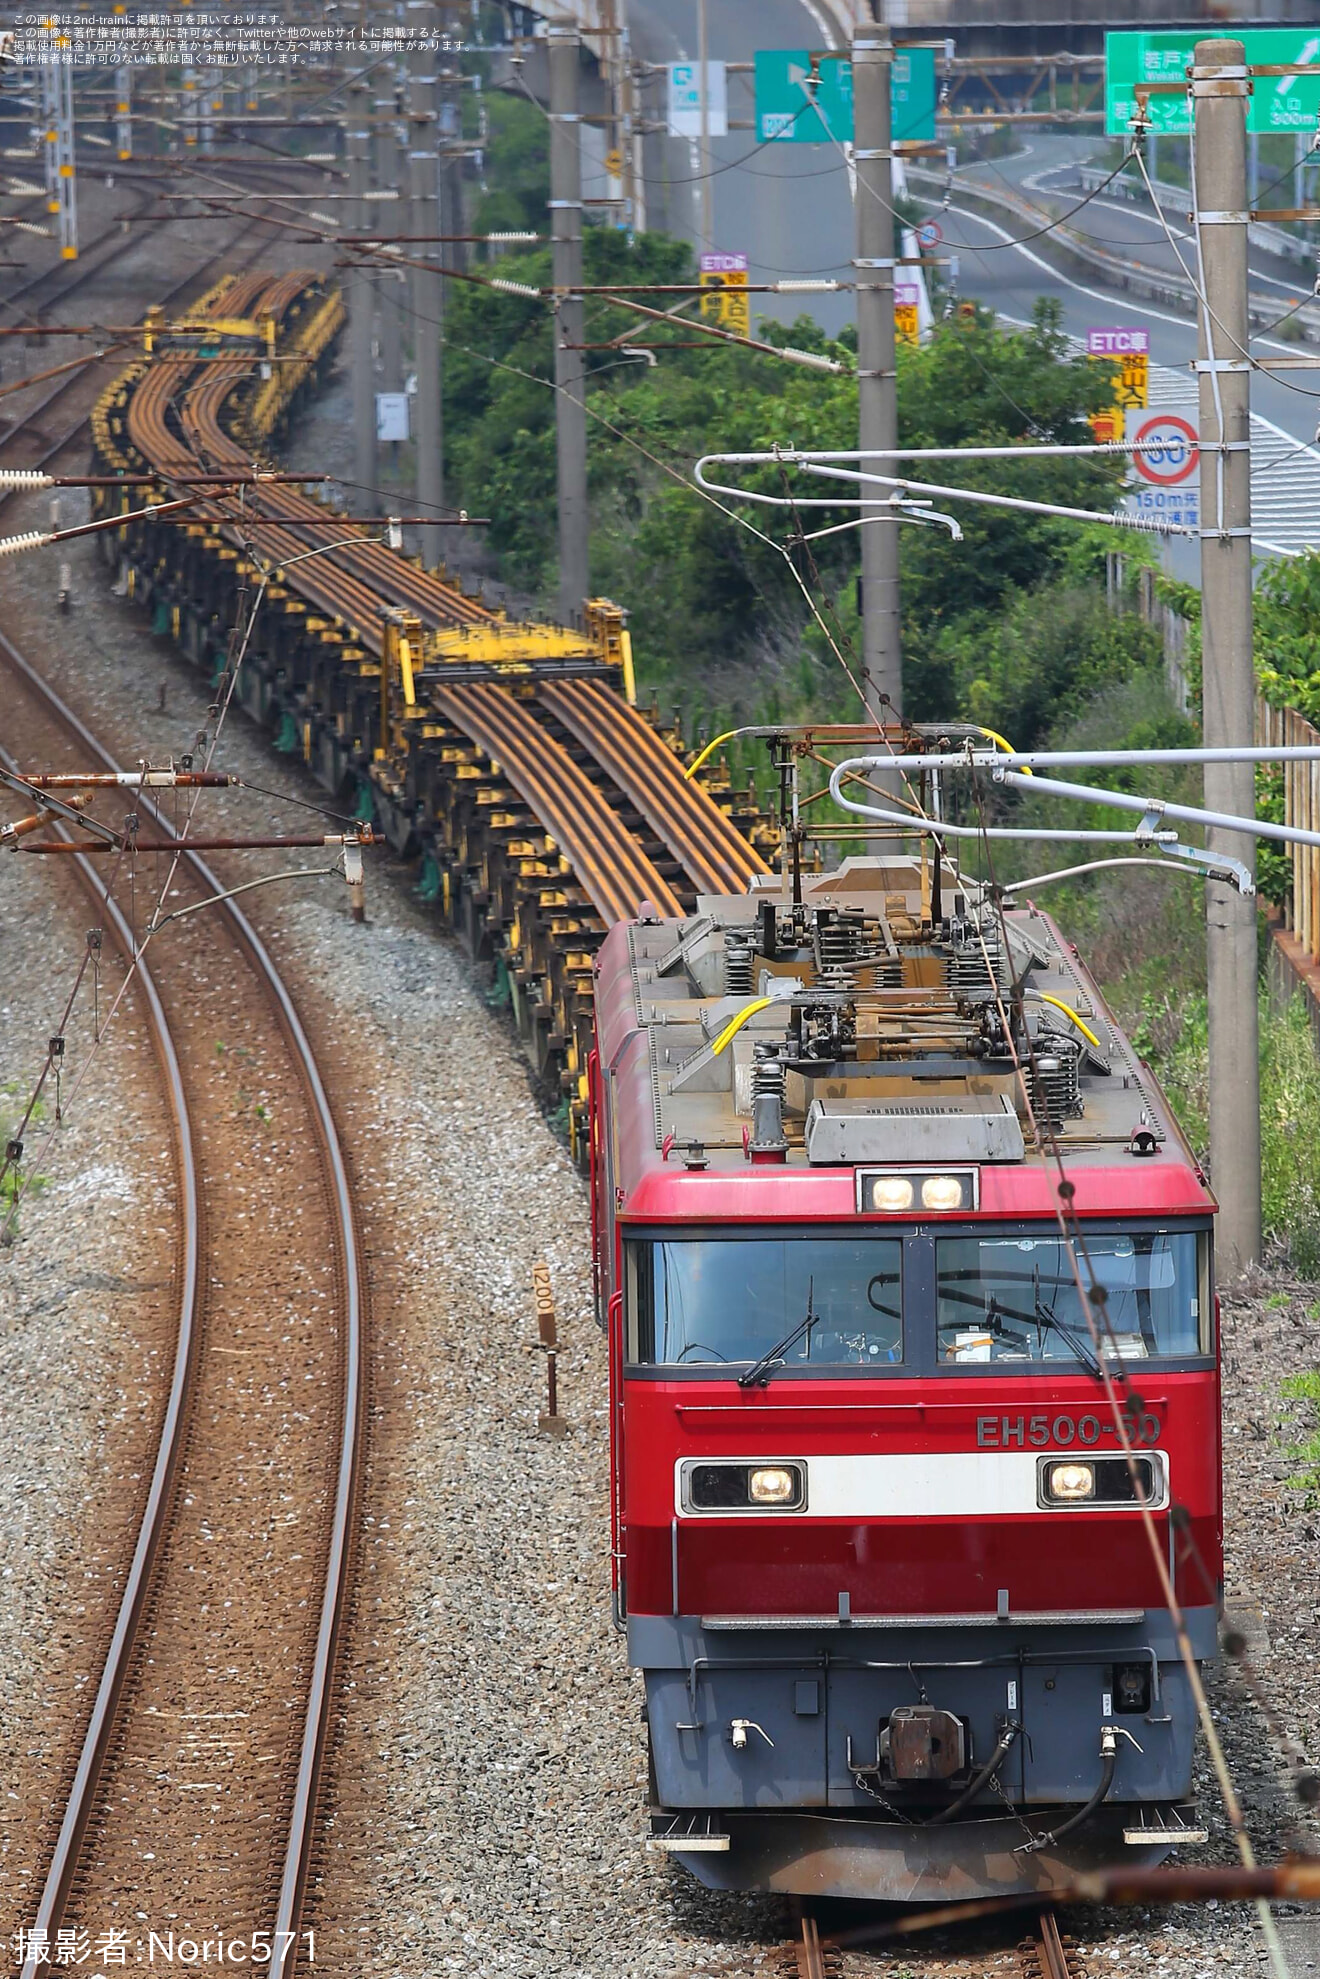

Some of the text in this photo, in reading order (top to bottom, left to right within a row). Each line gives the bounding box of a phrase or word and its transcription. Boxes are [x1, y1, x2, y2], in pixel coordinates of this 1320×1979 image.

[1270, 111, 1316, 125] 300m
[1090, 332, 1148, 352] ETC車
[533, 1267, 553, 1309] 1200
[977, 1414, 1161, 1447] EH500-50
